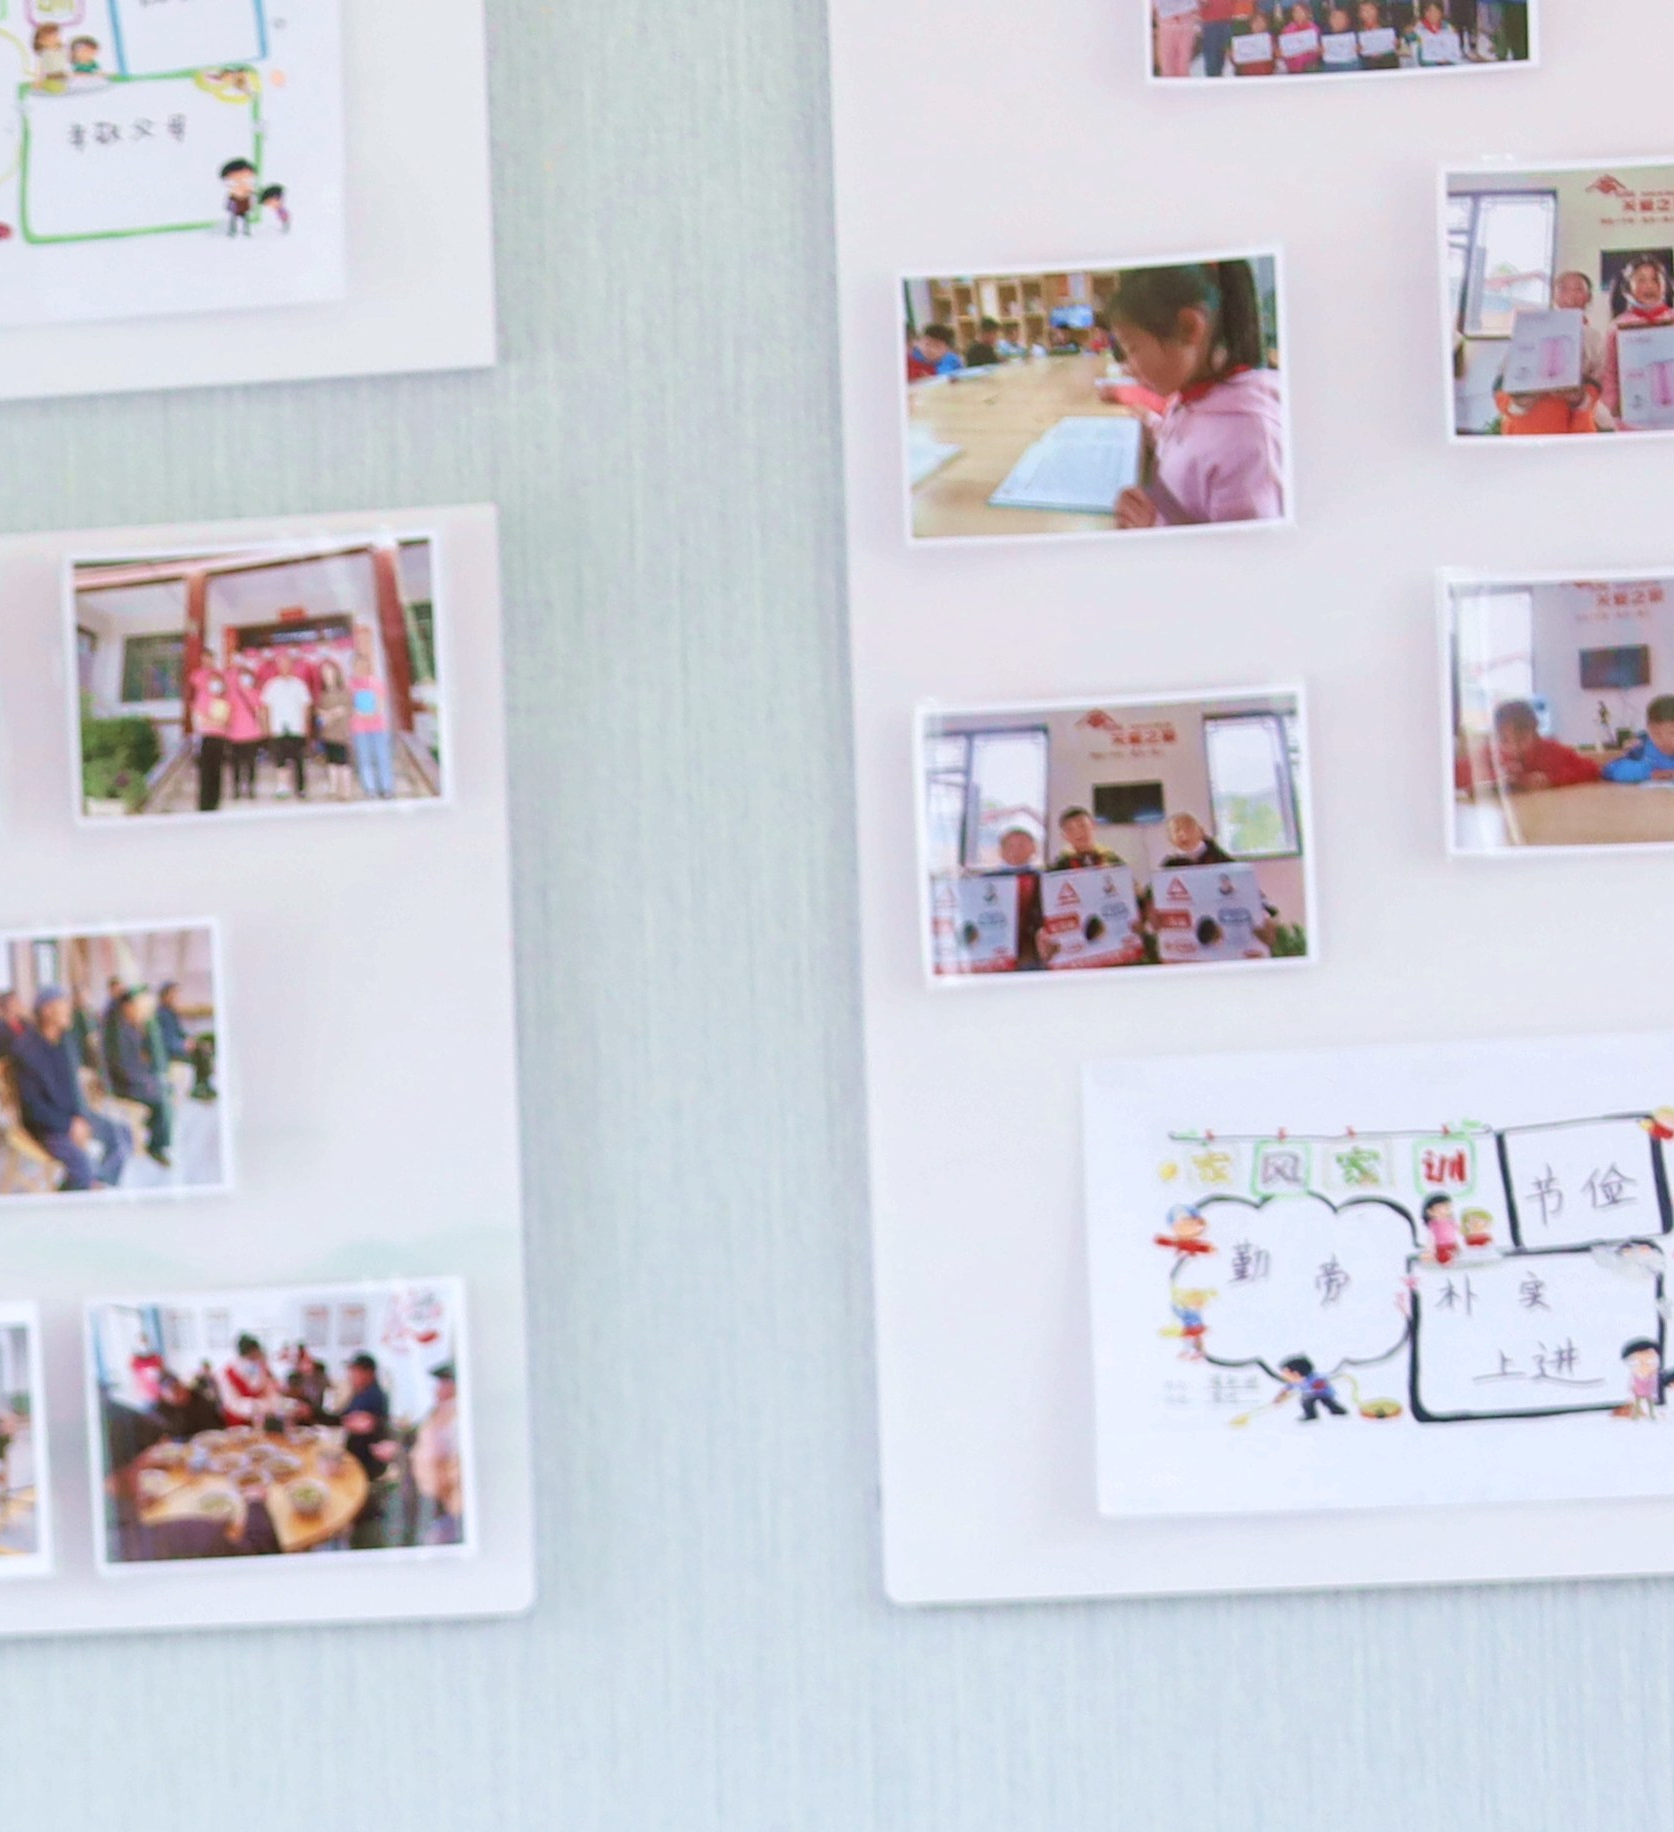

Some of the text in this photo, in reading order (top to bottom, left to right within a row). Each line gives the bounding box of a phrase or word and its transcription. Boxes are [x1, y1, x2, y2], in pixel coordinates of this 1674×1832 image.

[1228, 1241, 1351, 1306] 勤劳
[1437, 1275, 1552, 1315] 朴实
[1472, 1339, 1606, 1388] 上进
